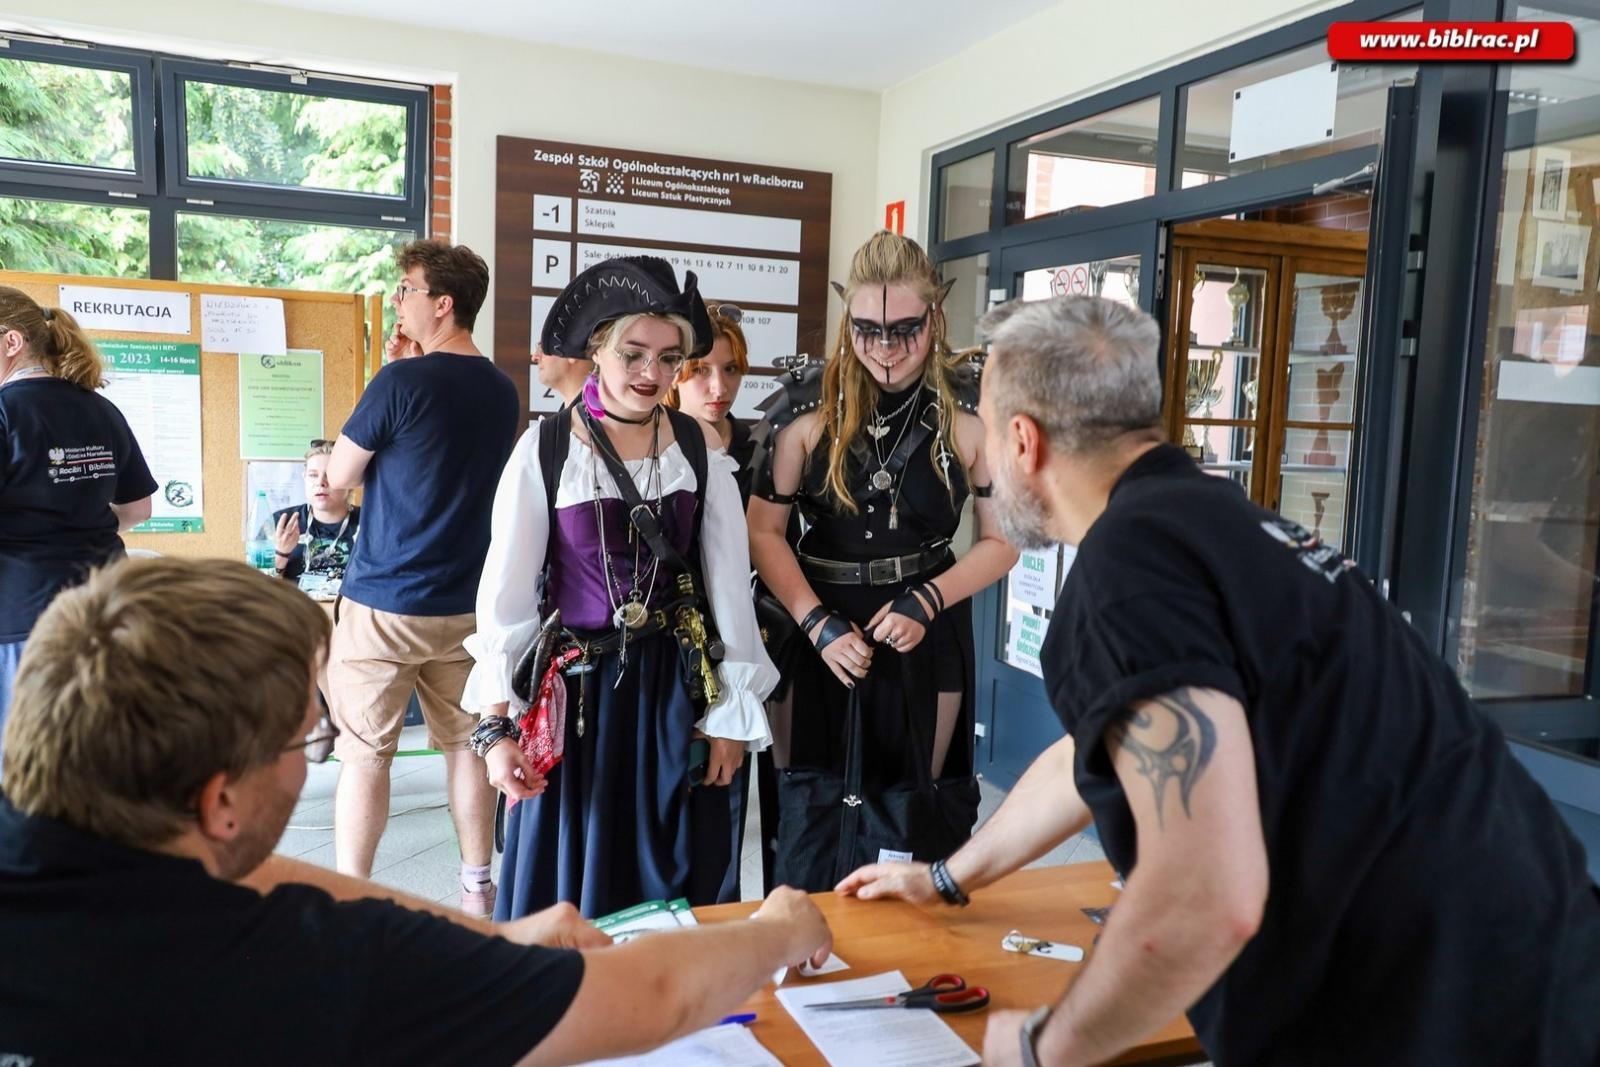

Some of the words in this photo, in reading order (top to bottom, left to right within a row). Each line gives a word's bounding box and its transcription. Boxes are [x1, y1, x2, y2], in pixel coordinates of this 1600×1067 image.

[533, 149, 574, 166] Zespół
[578, 154, 609, 169] Szkół
[613, 159, 720, 181] Ogólnokształcących
[636, 177, 663, 188] Liceum
[665, 181, 730, 196] Ogólnokształcące
[631, 188, 659, 199] Liceum
[661, 191, 682, 201] Sztuk
[684, 194, 732, 206] Plastycznych
[542, 204, 560, 224] -1
[584, 206, 616, 217] Szatnia
[584, 219, 616, 230] Sklepik
[545, 254, 560, 274] P
[584, 249, 602, 259] Sale
[671, 257, 680, 265] 19
[683, 258, 692, 267] 16
[695, 259, 704, 268] 13
[707, 260, 712, 269] 6
[716, 261, 724, 270] 12
[736, 263, 744, 271] 11
[767, 264, 776, 273] 21
[779, 265, 789, 274] 20
[73, 301, 172, 318] REKRUTACJA
[120, 352, 151, 364] 2023
[160, 356, 178, 364] 14-16
[744, 380, 759, 389] 200
[761, 382, 775, 390] 210
